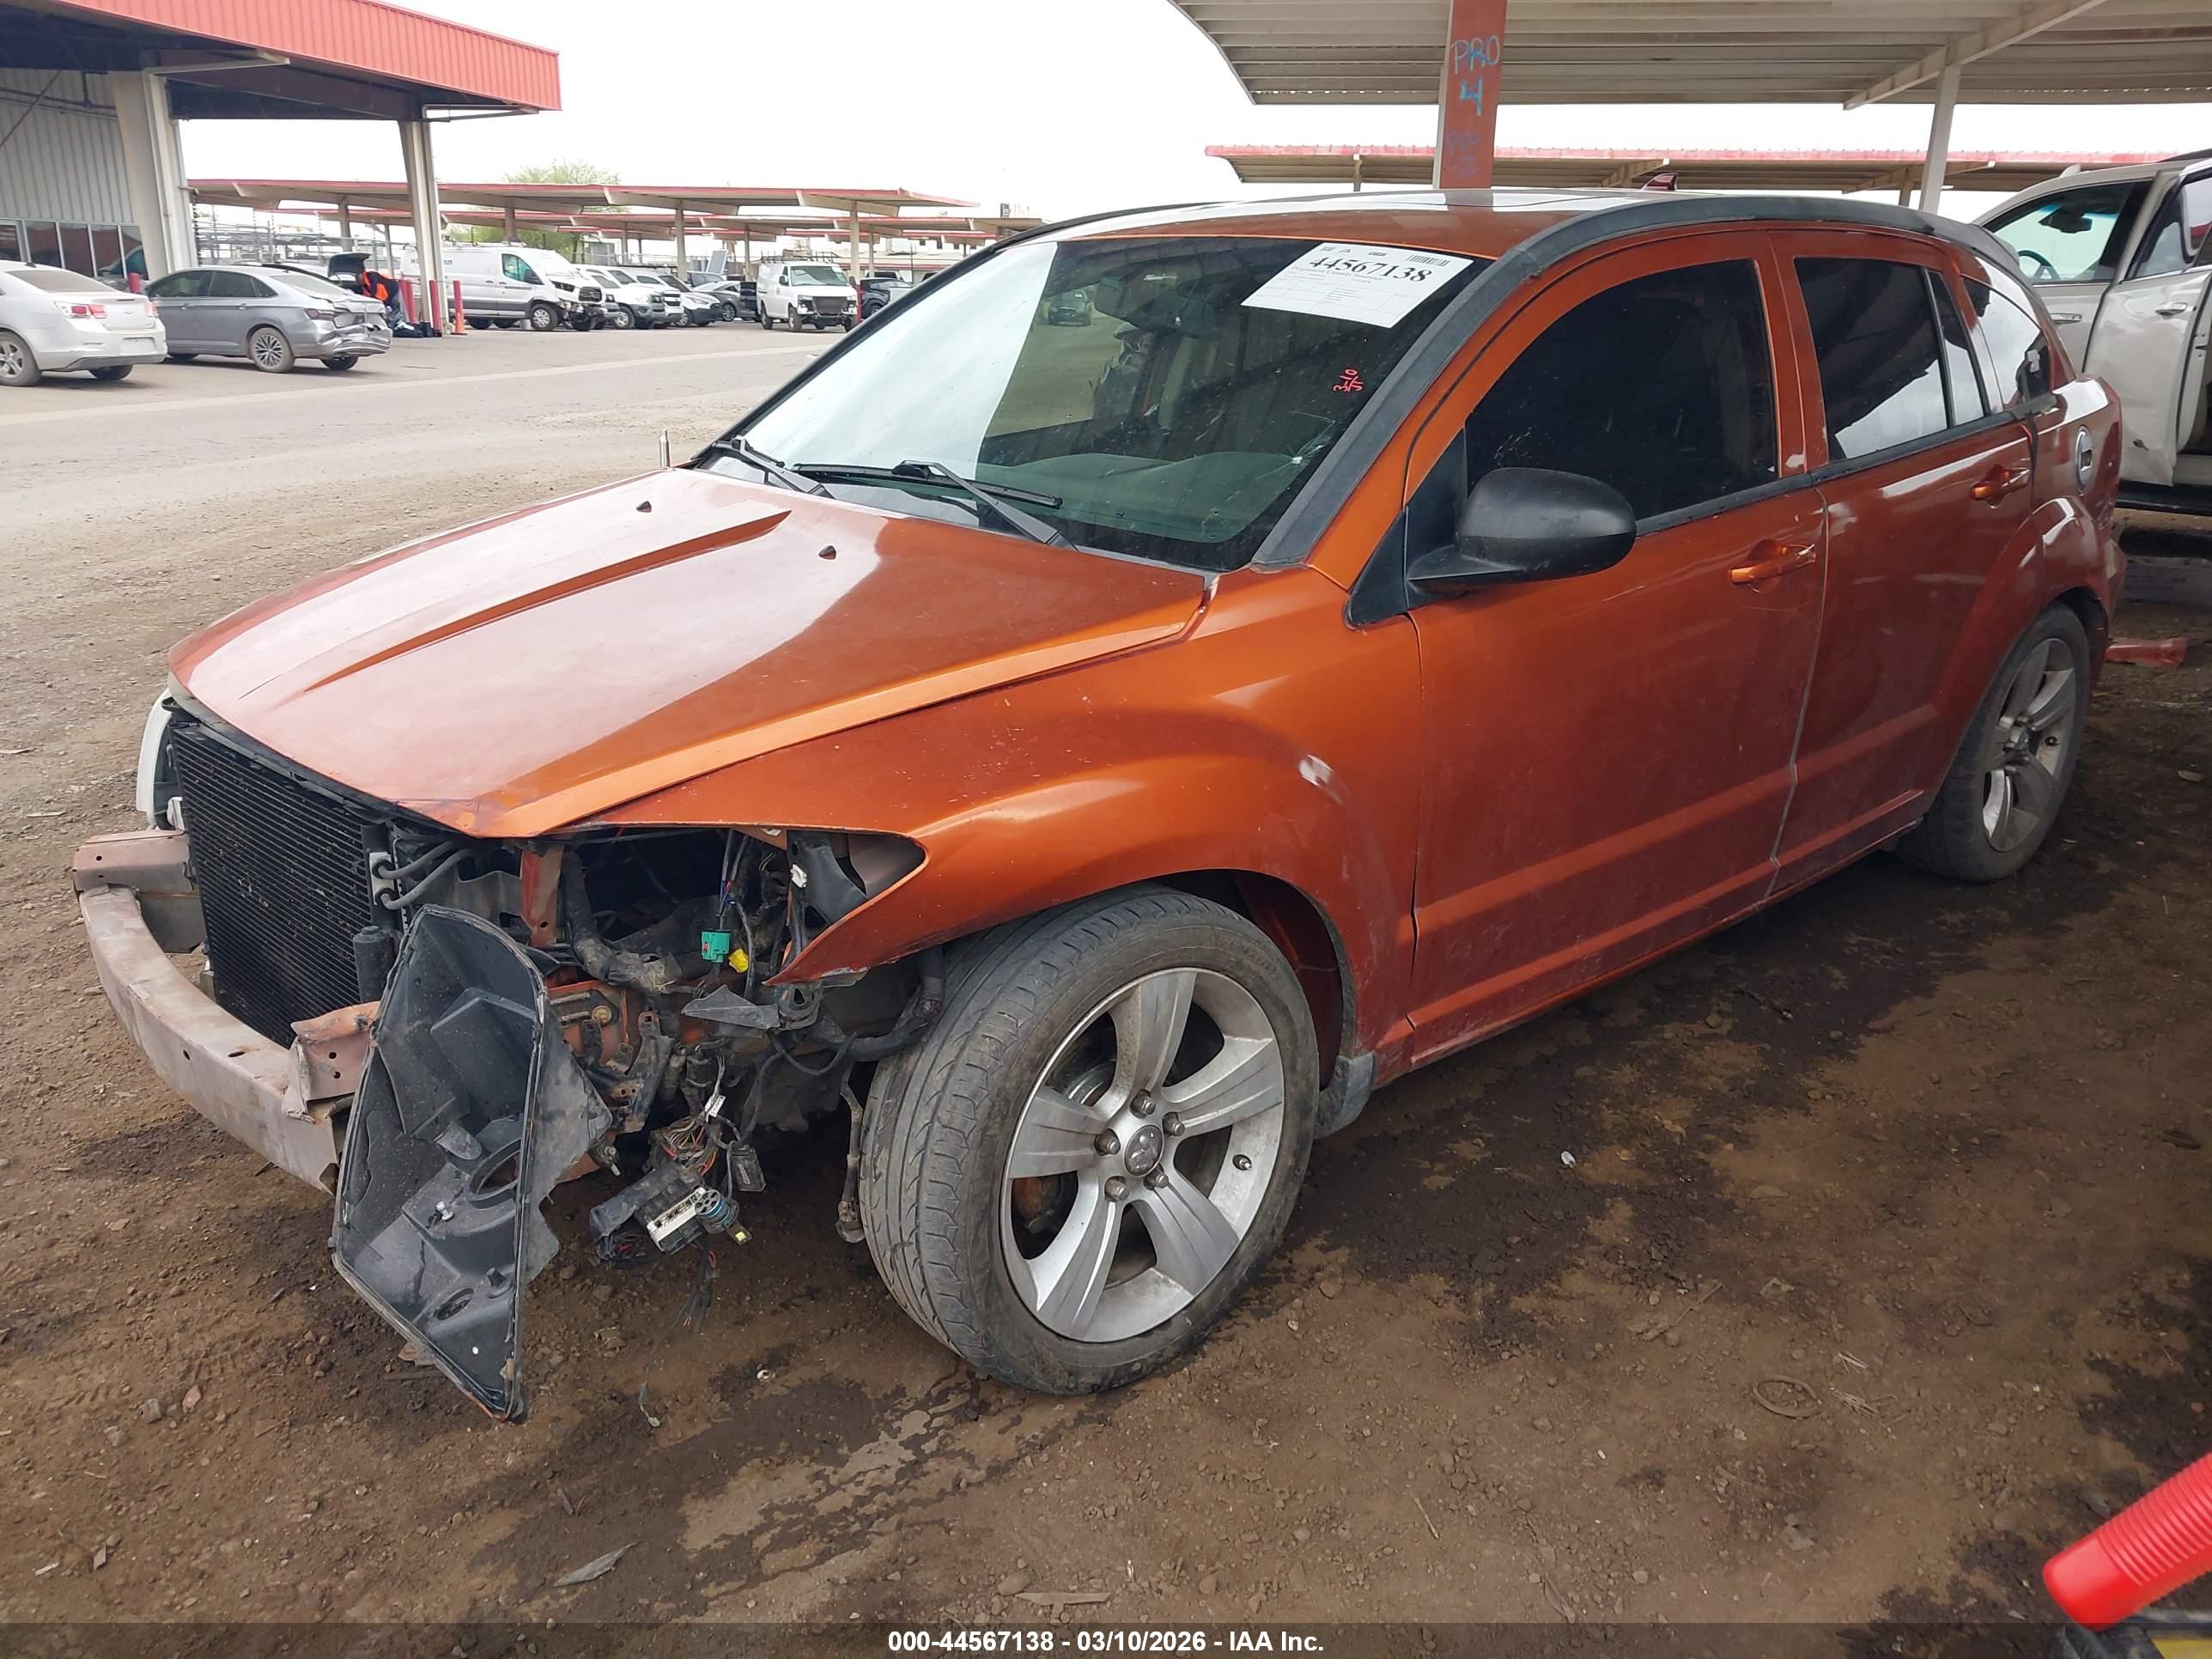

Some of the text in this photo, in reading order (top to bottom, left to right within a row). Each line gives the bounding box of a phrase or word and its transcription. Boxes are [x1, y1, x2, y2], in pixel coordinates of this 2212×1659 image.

[1451, 34, 1501, 75] PRO
[1459, 75, 1484, 116] 4
[1309, 256, 1433, 283] 44567138
